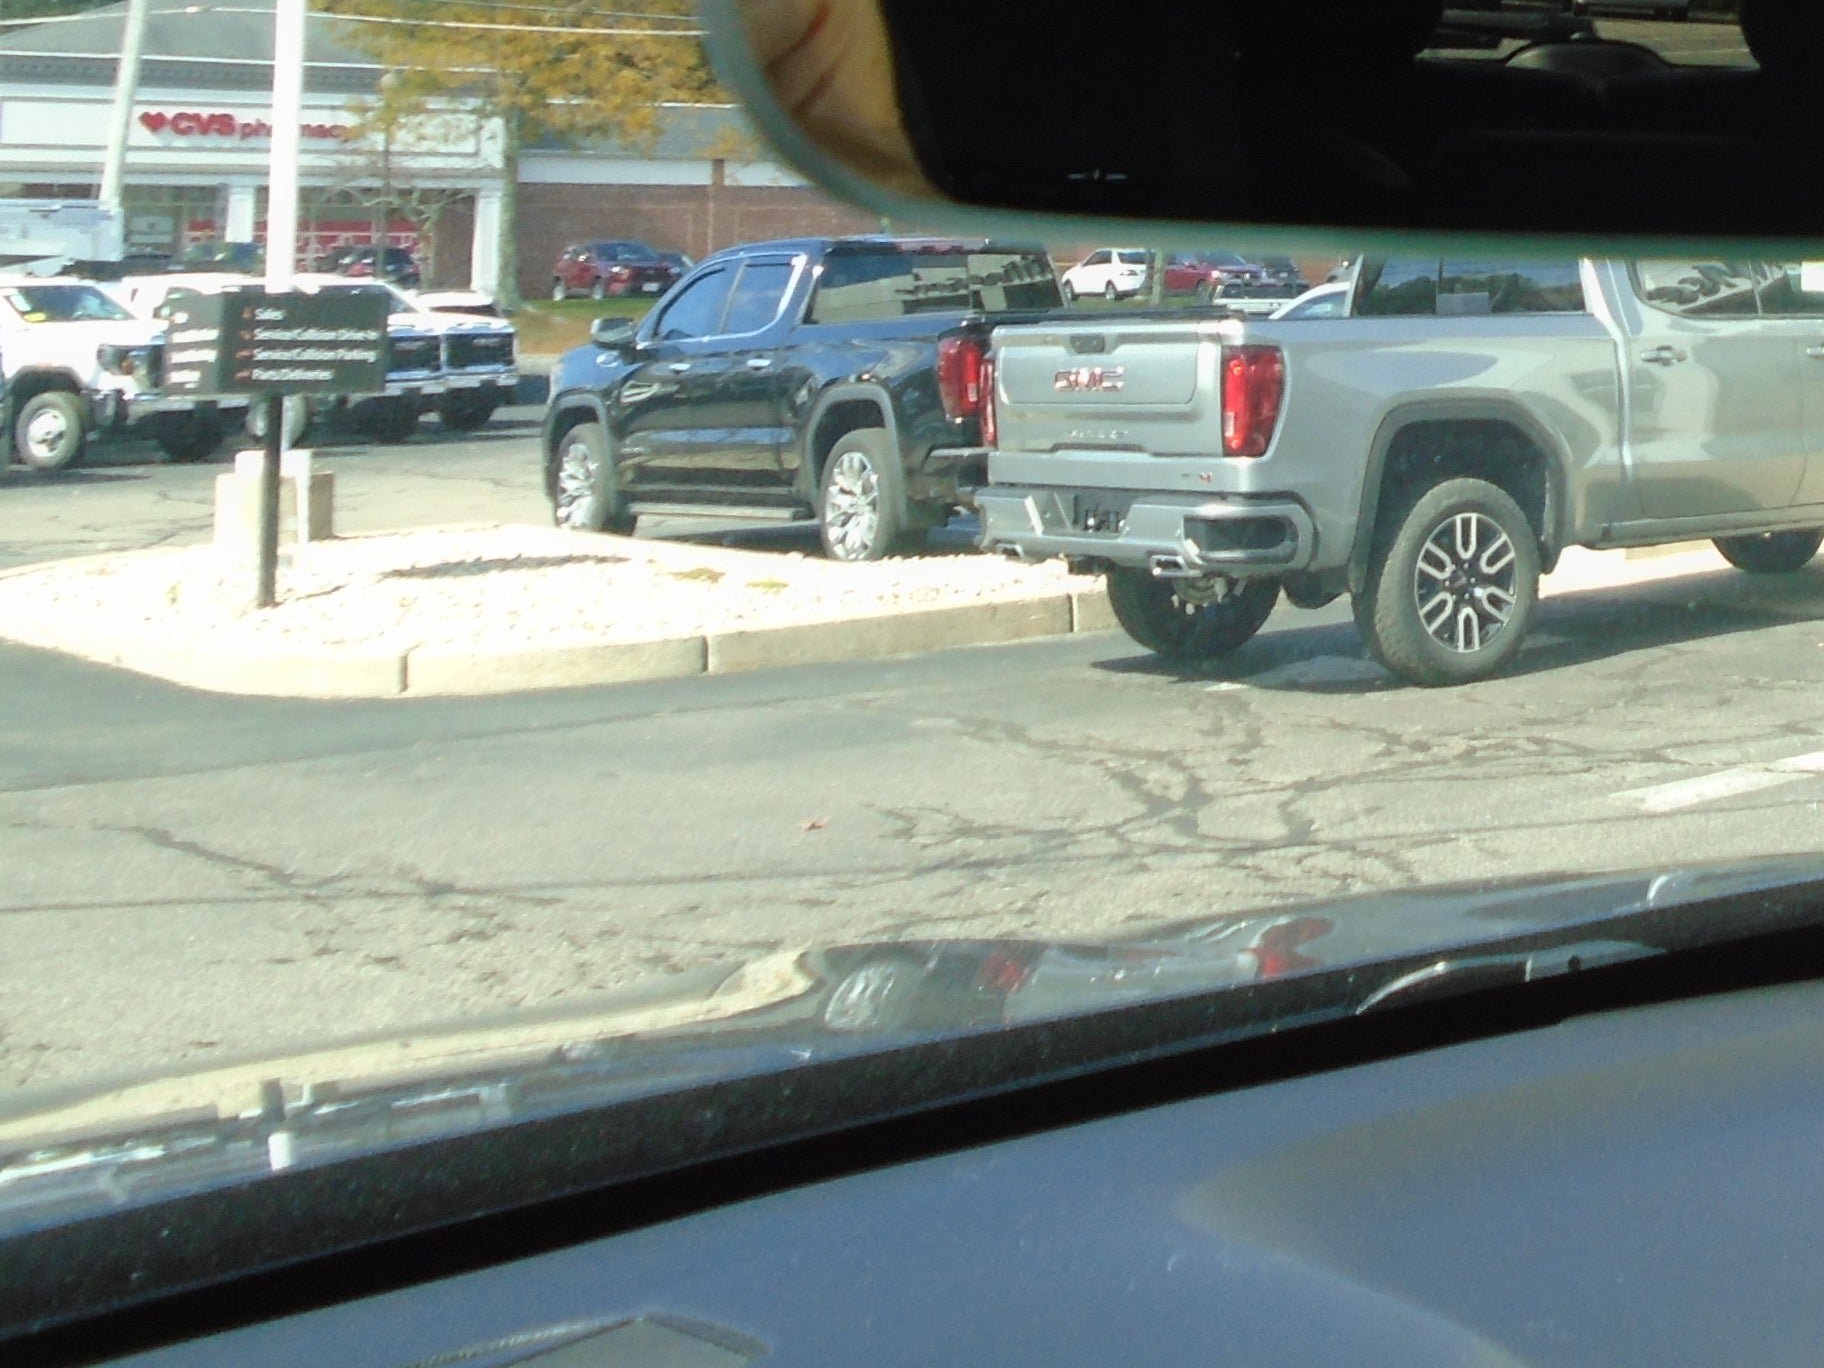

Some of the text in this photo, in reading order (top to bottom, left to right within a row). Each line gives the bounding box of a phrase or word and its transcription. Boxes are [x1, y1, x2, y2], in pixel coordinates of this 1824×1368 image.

[171, 111, 356, 143] CVS phmac
[1055, 366, 1124, 393] GMC
